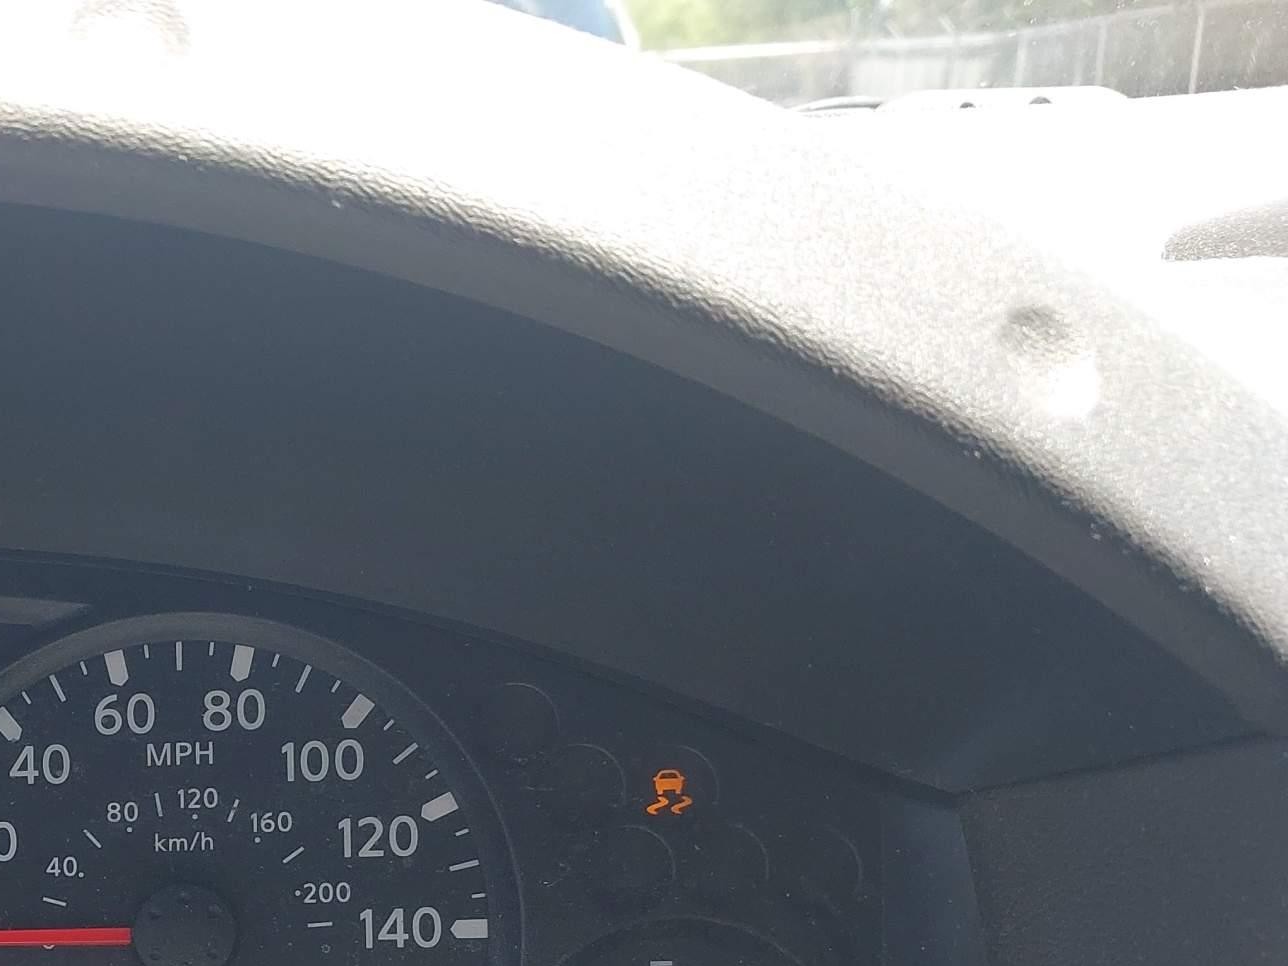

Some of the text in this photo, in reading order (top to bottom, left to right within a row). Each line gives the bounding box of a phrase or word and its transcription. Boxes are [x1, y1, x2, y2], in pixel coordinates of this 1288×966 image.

[94, 693, 155, 735] 60
[202, 688, 267, 732] 80
[9, 744, 70, 785] 40
[146, 742, 214, 767] MPH
[281, 738, 364, 782] 100
[177, 787, 219, 810] 120
[106, 801, 139, 823] 80
[250, 811, 293, 833] 160
[154, 831, 215, 853] km/h
[338, 815, 419, 858] 120
[45, 856, 78, 878] 40
[303, 882, 351, 904] 200
[359, 906, 442, 949] 140
